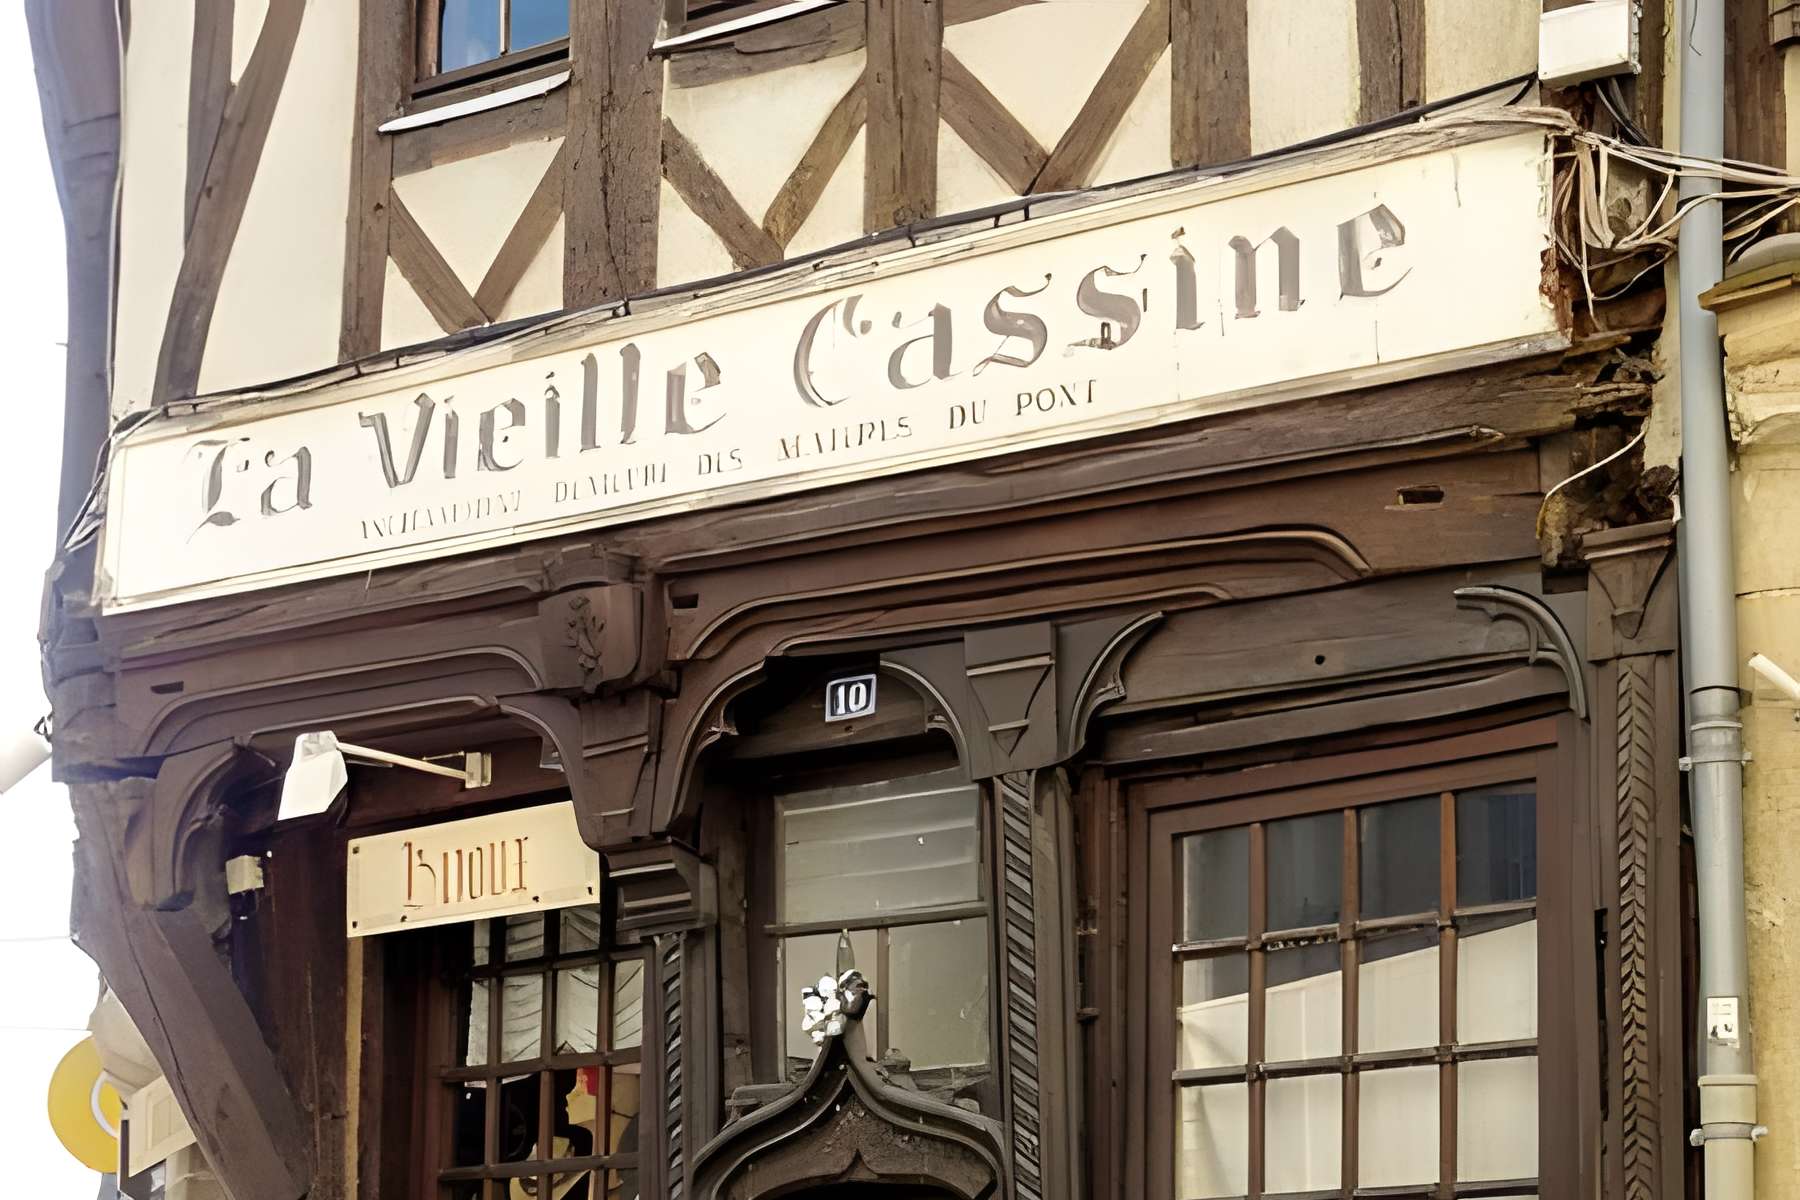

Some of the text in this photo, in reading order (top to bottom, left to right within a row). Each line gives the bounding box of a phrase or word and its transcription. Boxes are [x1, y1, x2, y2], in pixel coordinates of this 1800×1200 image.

[187, 201, 1413, 544] La Vieille Cassine
[949, 399, 986, 429] DU
[1015, 379, 1097, 416] PONT
[834, 682, 867, 715] 10
